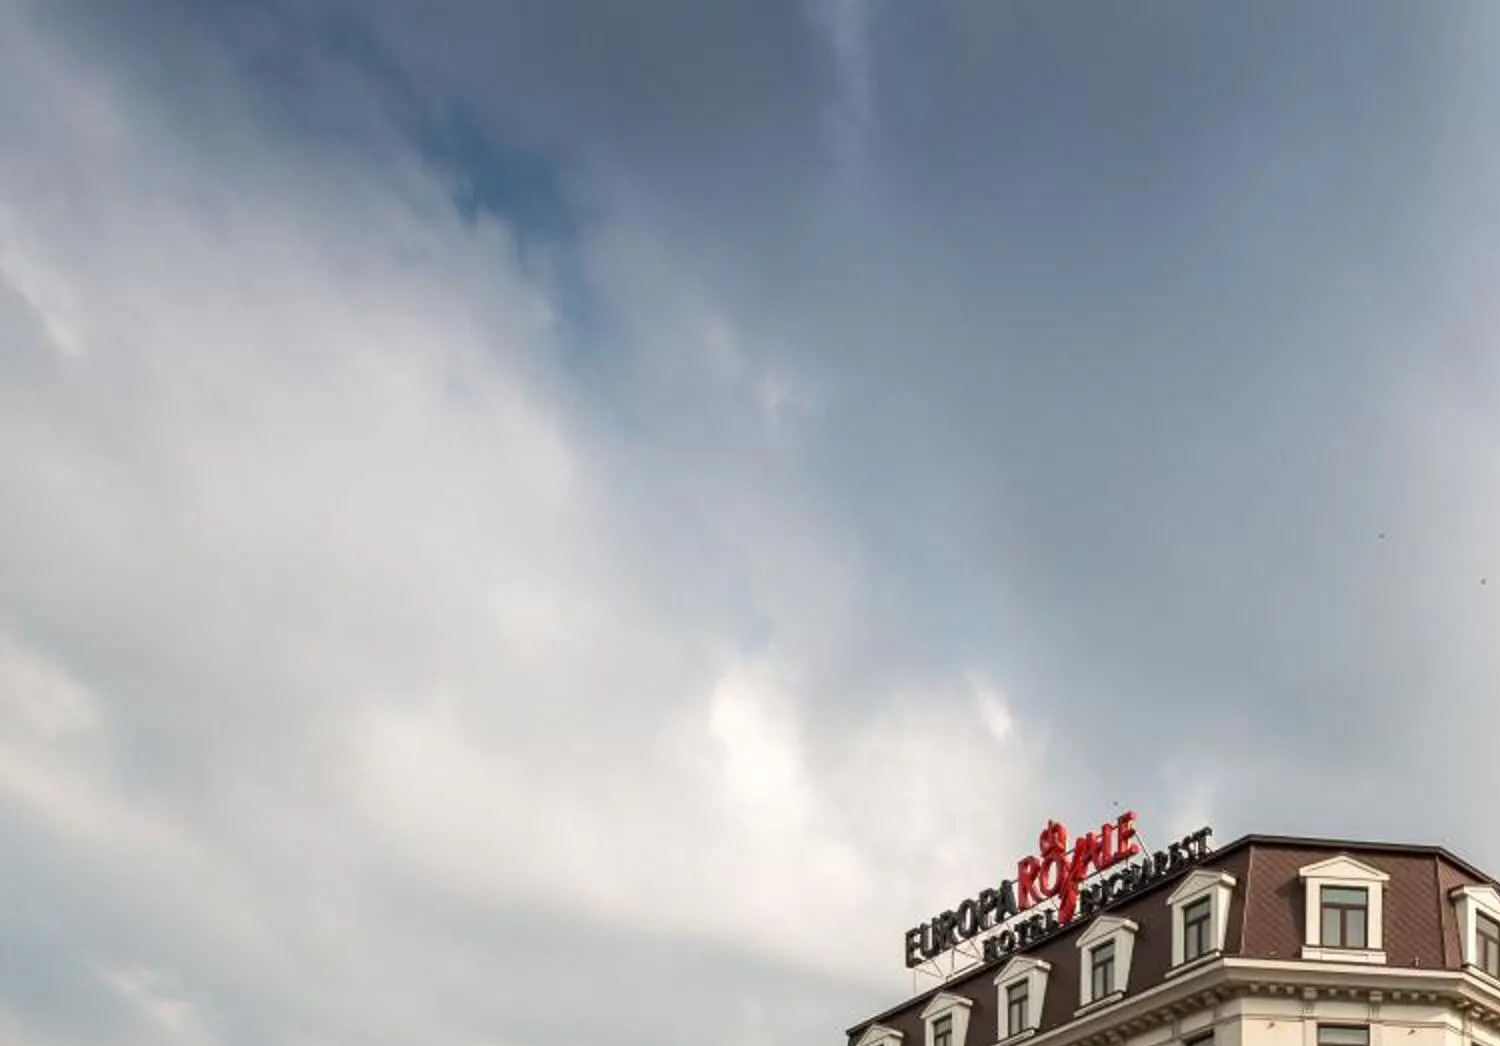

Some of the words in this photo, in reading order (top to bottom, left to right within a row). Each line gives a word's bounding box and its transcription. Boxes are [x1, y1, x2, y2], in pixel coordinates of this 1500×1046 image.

[905, 879, 1018, 968] EUROPA
[1017, 811, 1139, 927] ROYALE
[982, 906, 1060, 963] HOTEL
[1079, 826, 1213, 915] BUCHAREST
